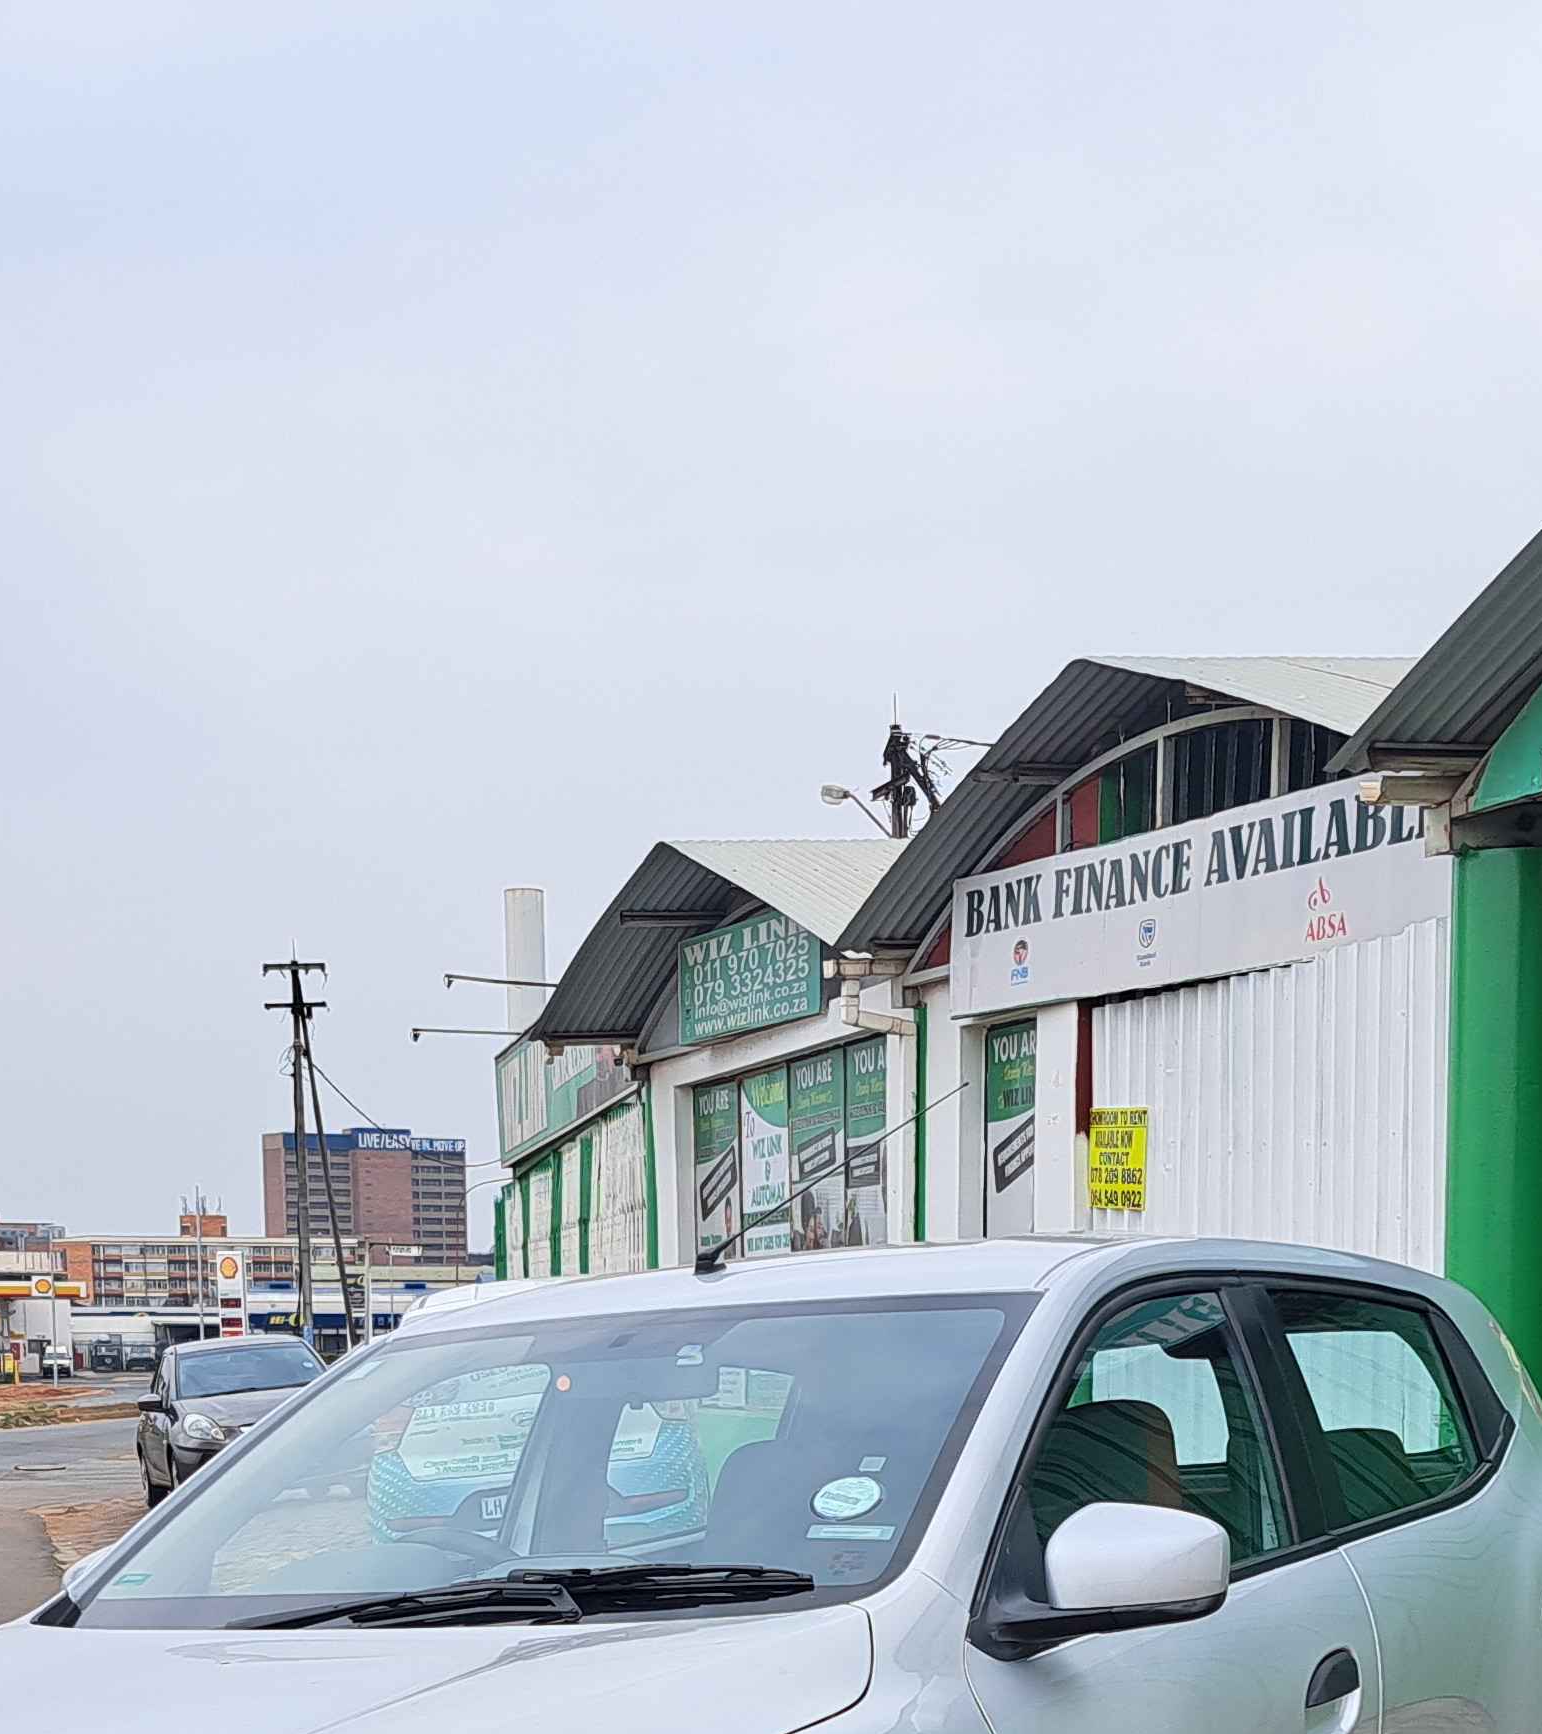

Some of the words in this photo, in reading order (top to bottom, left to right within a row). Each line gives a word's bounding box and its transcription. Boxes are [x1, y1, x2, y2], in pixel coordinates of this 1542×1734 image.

[964, 874, 1042, 938] BANK
[1052, 838, 1192, 919] FINANCE
[1306, 913, 1347, 942] ABSA
[683, 933, 732, 966] WIZ
[693, 960, 721, 985] 011
[728, 948, 758, 976] 970
[764, 932, 809, 964] 7025
[694, 979, 725, 1005] 079
[730, 955, 809, 996] 3324325
[694, 998, 808, 1036] www.wizlink.co.za
[854, 1048, 875, 1076] YOU
[993, 1033, 1018, 1064] YOU
[795, 1063, 814, 1090] YOU
[815, 1058, 833, 1086] ARE
[1130, 1110, 1147, 1125] RENT
[358, 1132, 411, 1149] LIVE/EASY
[1099, 1151, 1130, 1166] CONTACT
[1104, 1189, 1119, 1206] 549
[1121, 1190, 1143, 1208] 0922
